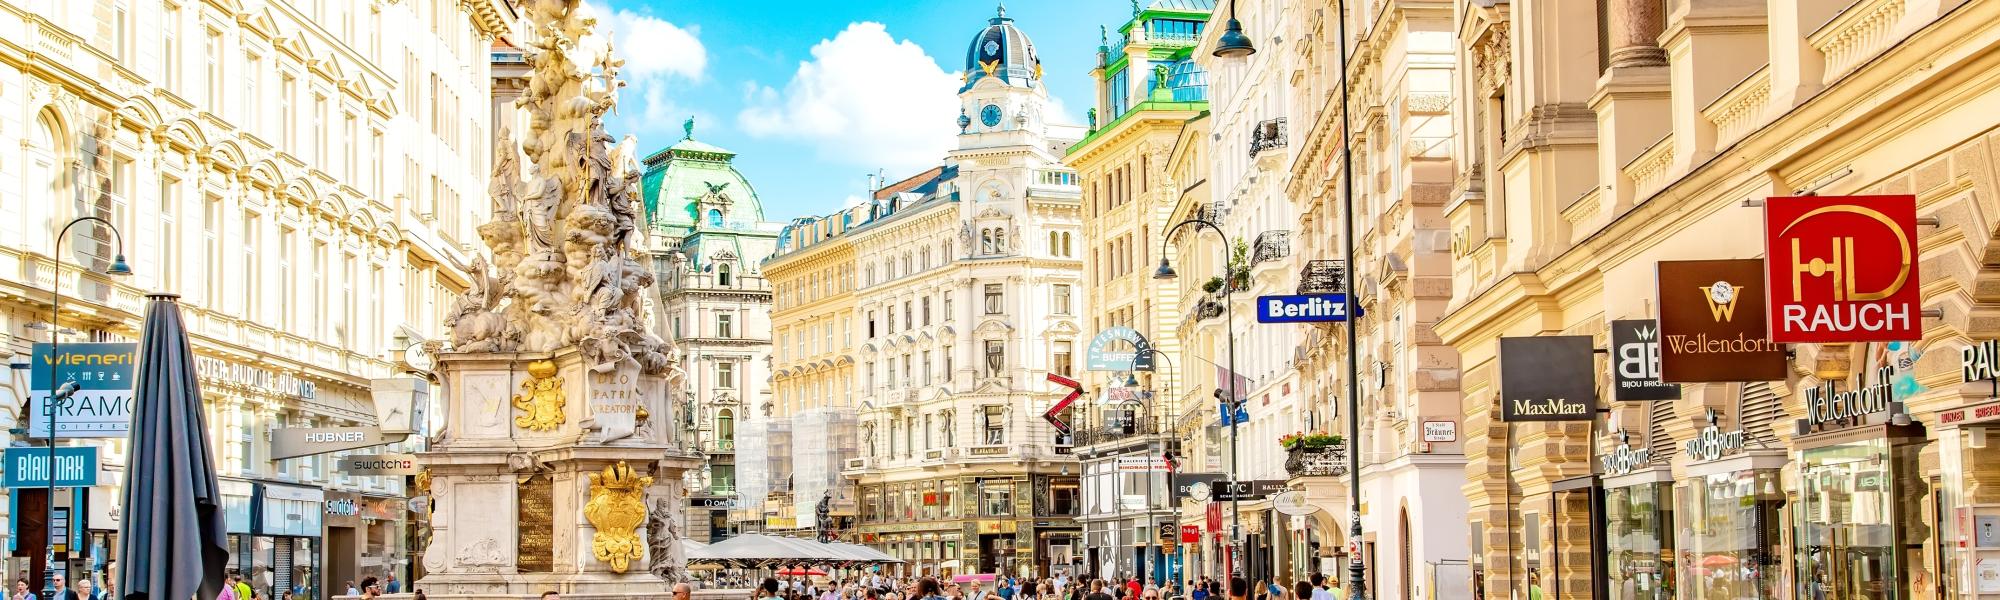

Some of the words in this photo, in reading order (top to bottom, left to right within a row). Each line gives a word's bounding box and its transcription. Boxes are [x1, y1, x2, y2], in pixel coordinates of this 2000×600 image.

[1268, 297, 1345, 317] Berlitz
[1783, 302, 1910, 332] RAUCH
[1622, 380, 1642, 389] BIJOU
[592, 389, 632, 399] PATRI
[1803, 365, 1894, 426] Wellendorff
[1513, 398, 1587, 416] MaxMara
[305, 432, 364, 443] HÜBNER
[354, 459, 402, 470] swatch
